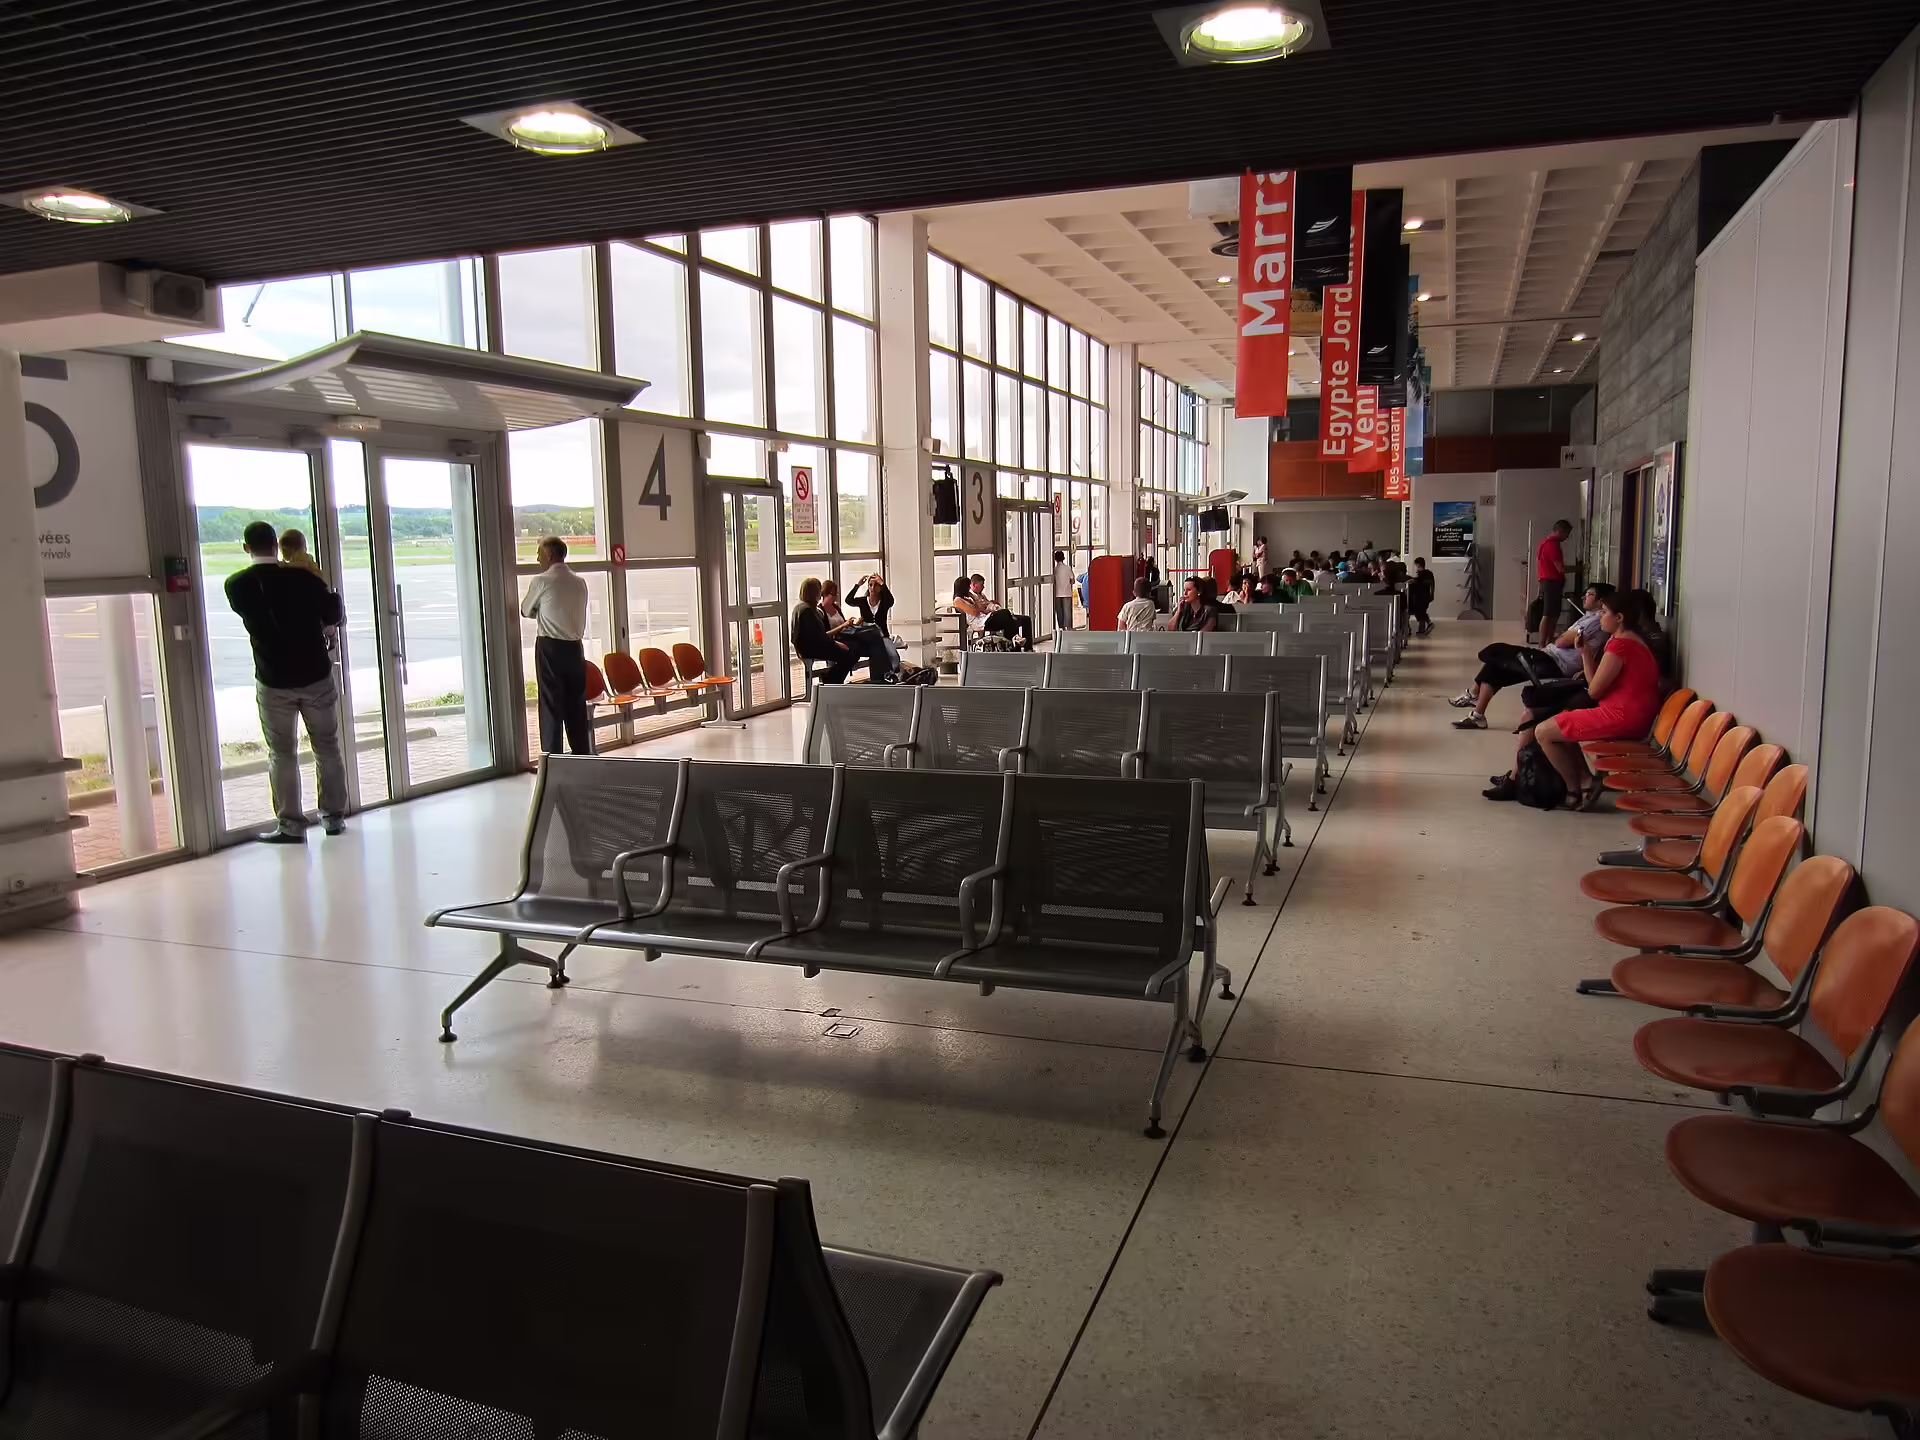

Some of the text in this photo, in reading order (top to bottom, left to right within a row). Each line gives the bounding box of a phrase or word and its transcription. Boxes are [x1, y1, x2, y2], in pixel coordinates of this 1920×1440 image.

[1323, 359, 1353, 455] Egypte
[1353, 386, 1375, 454] Veni
[638, 433, 671, 520] 4
[1386, 407, 1401, 495] Iles Canari
[972, 471, 984, 525] 3
